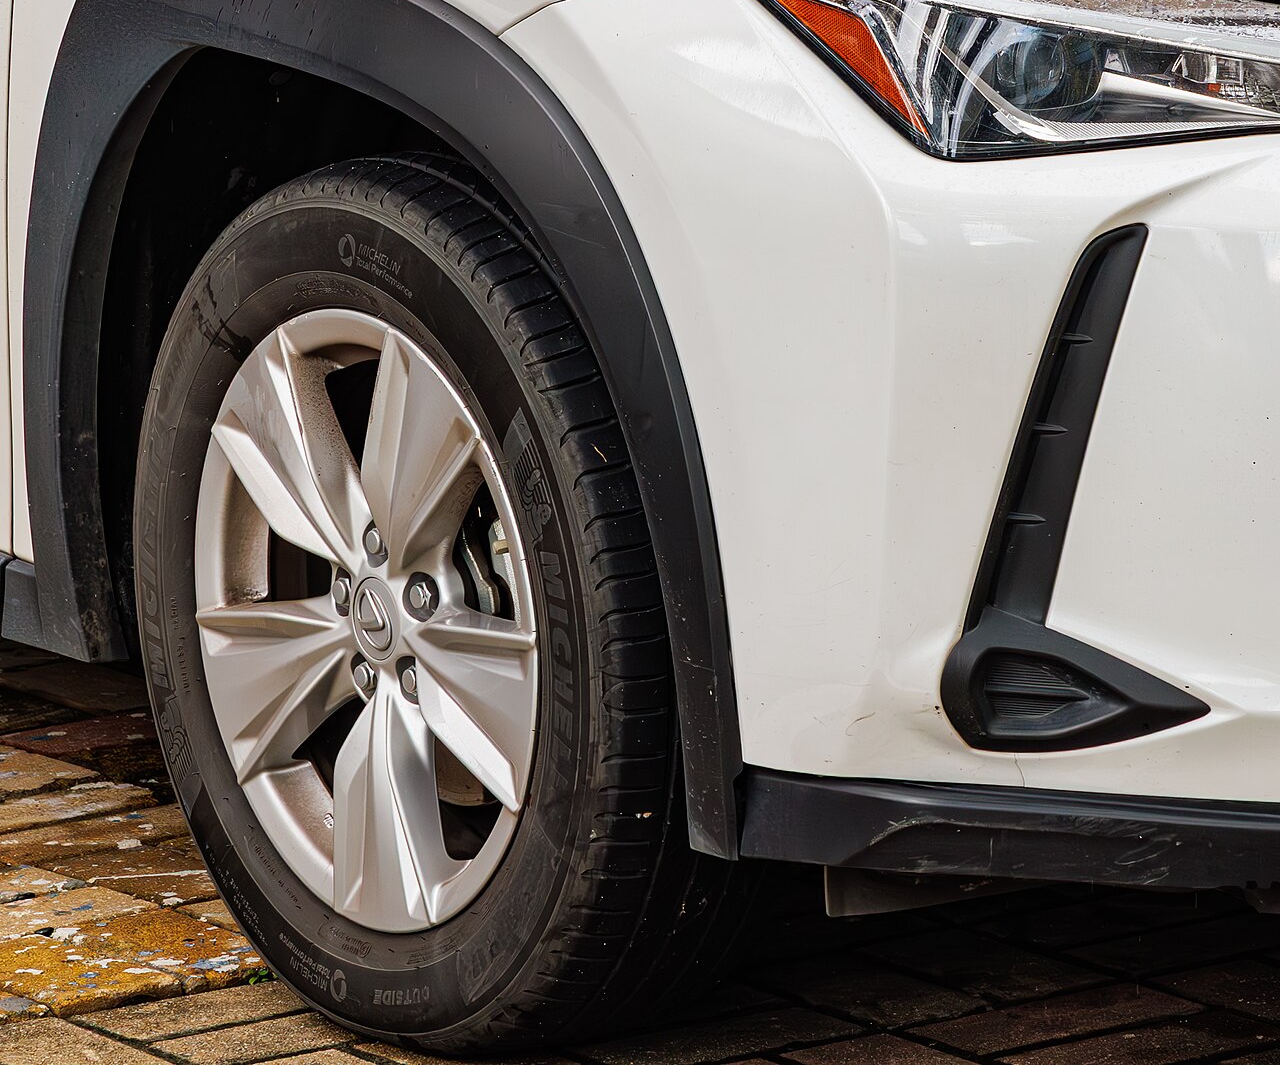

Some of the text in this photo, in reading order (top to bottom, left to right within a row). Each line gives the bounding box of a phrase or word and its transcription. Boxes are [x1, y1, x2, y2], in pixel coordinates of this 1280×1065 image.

[358, 243, 401, 275] MICHELIN
[355, 256, 371, 270] Total
[371, 261, 413, 299] Performance
[289, 956, 328, 991] MICHELIN
[372, 985, 430, 1005] OUTSIDE
